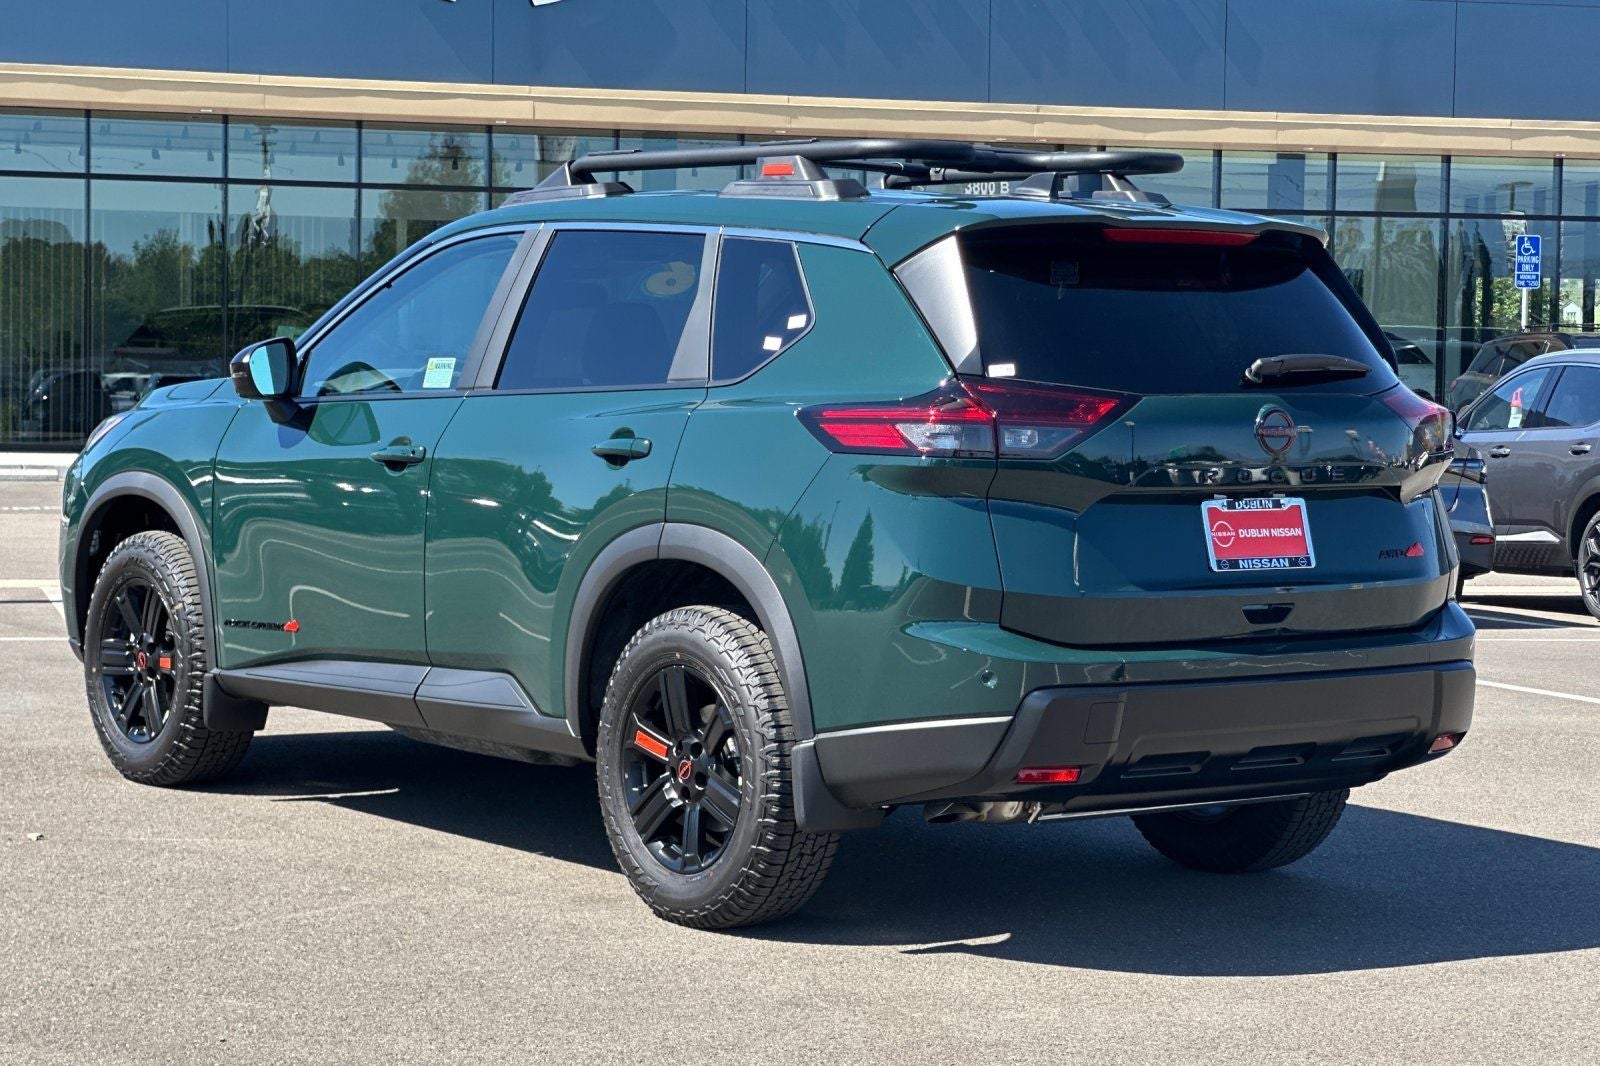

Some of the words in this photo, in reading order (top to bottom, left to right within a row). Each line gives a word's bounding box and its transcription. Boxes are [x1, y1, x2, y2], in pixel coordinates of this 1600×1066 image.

[965, 182, 995, 194] 3800
[1517, 255, 1539, 263] PARKING
[1258, 427, 1297, 437] NISSAN
[1202, 467, 1345, 485] ROGUE
[1235, 500, 1273, 509] DUBLIN
[1238, 529, 1270, 538] DUBLIN
[1270, 527, 1302, 537] NISSAN
[1238, 558, 1290, 569] NISSAN
